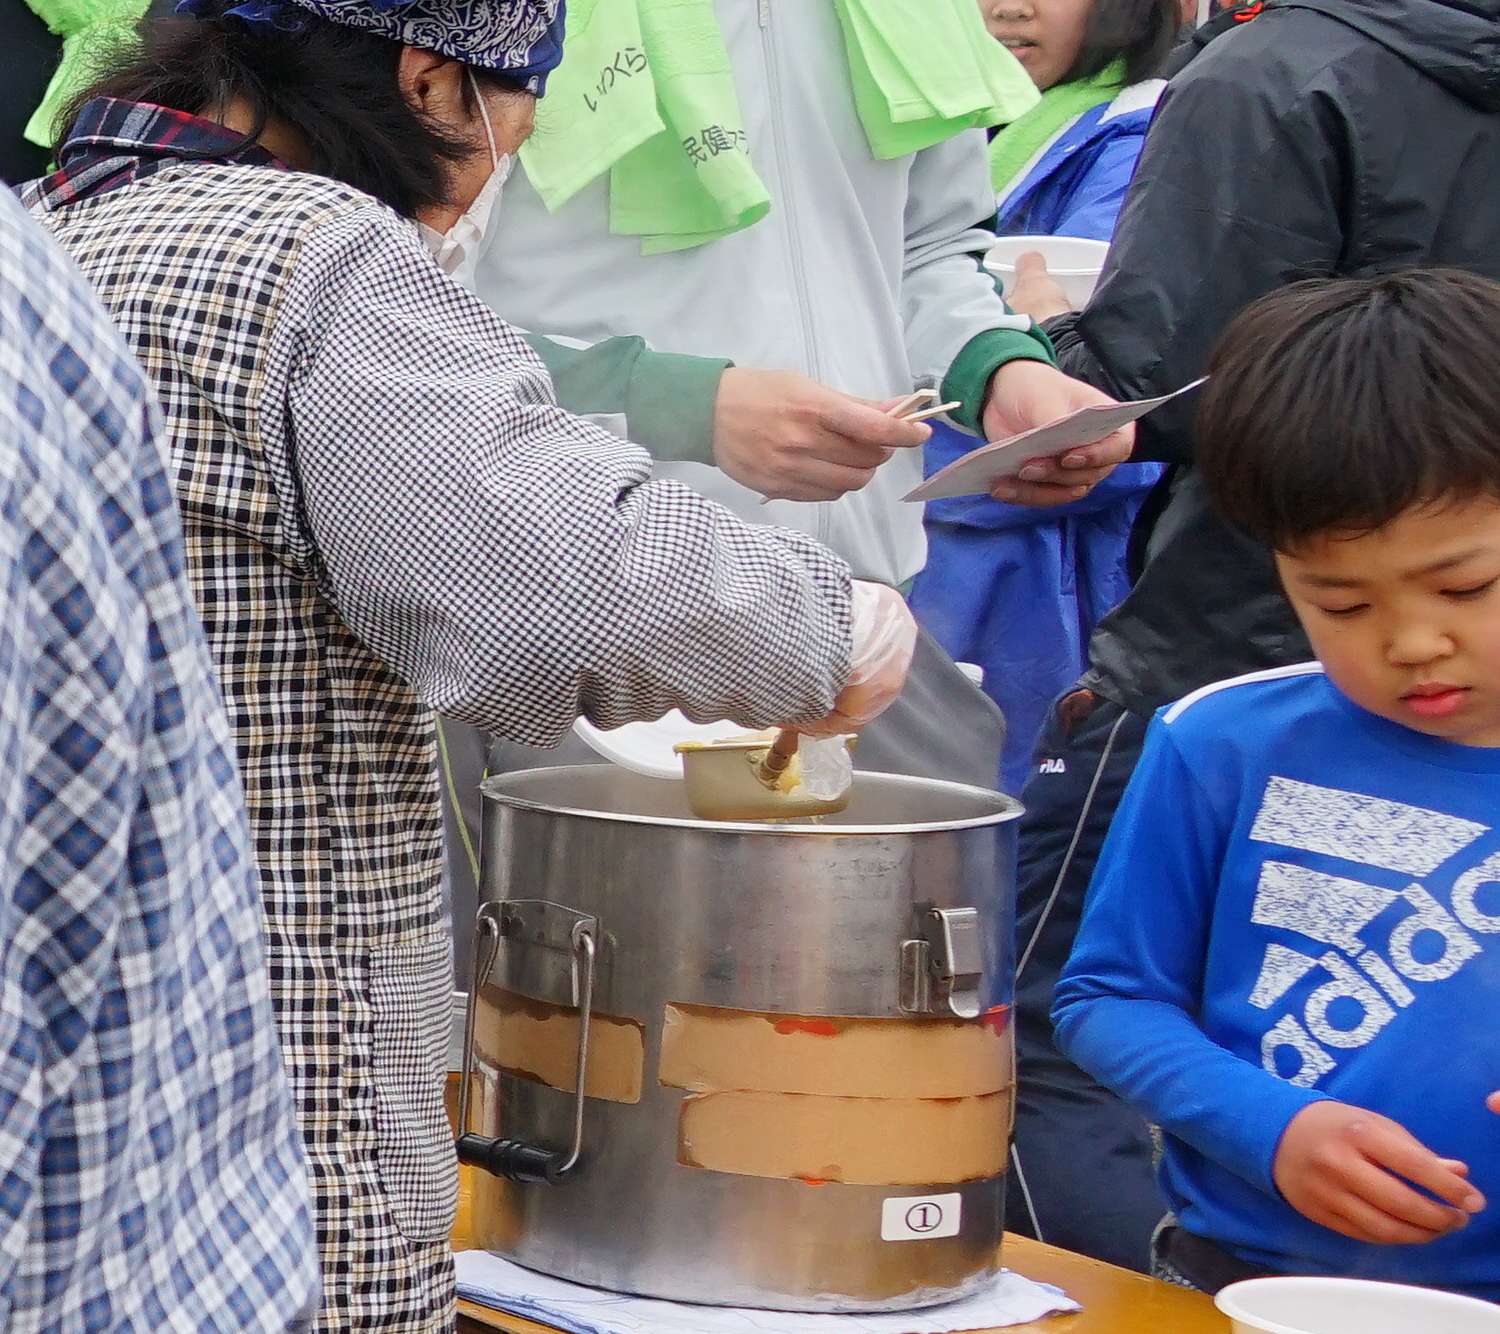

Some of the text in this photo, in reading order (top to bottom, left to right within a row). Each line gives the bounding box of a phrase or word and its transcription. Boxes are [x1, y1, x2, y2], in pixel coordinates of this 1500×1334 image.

[582, 45, 647, 113] いわくら
[1038, 757, 1066, 774] FILA
